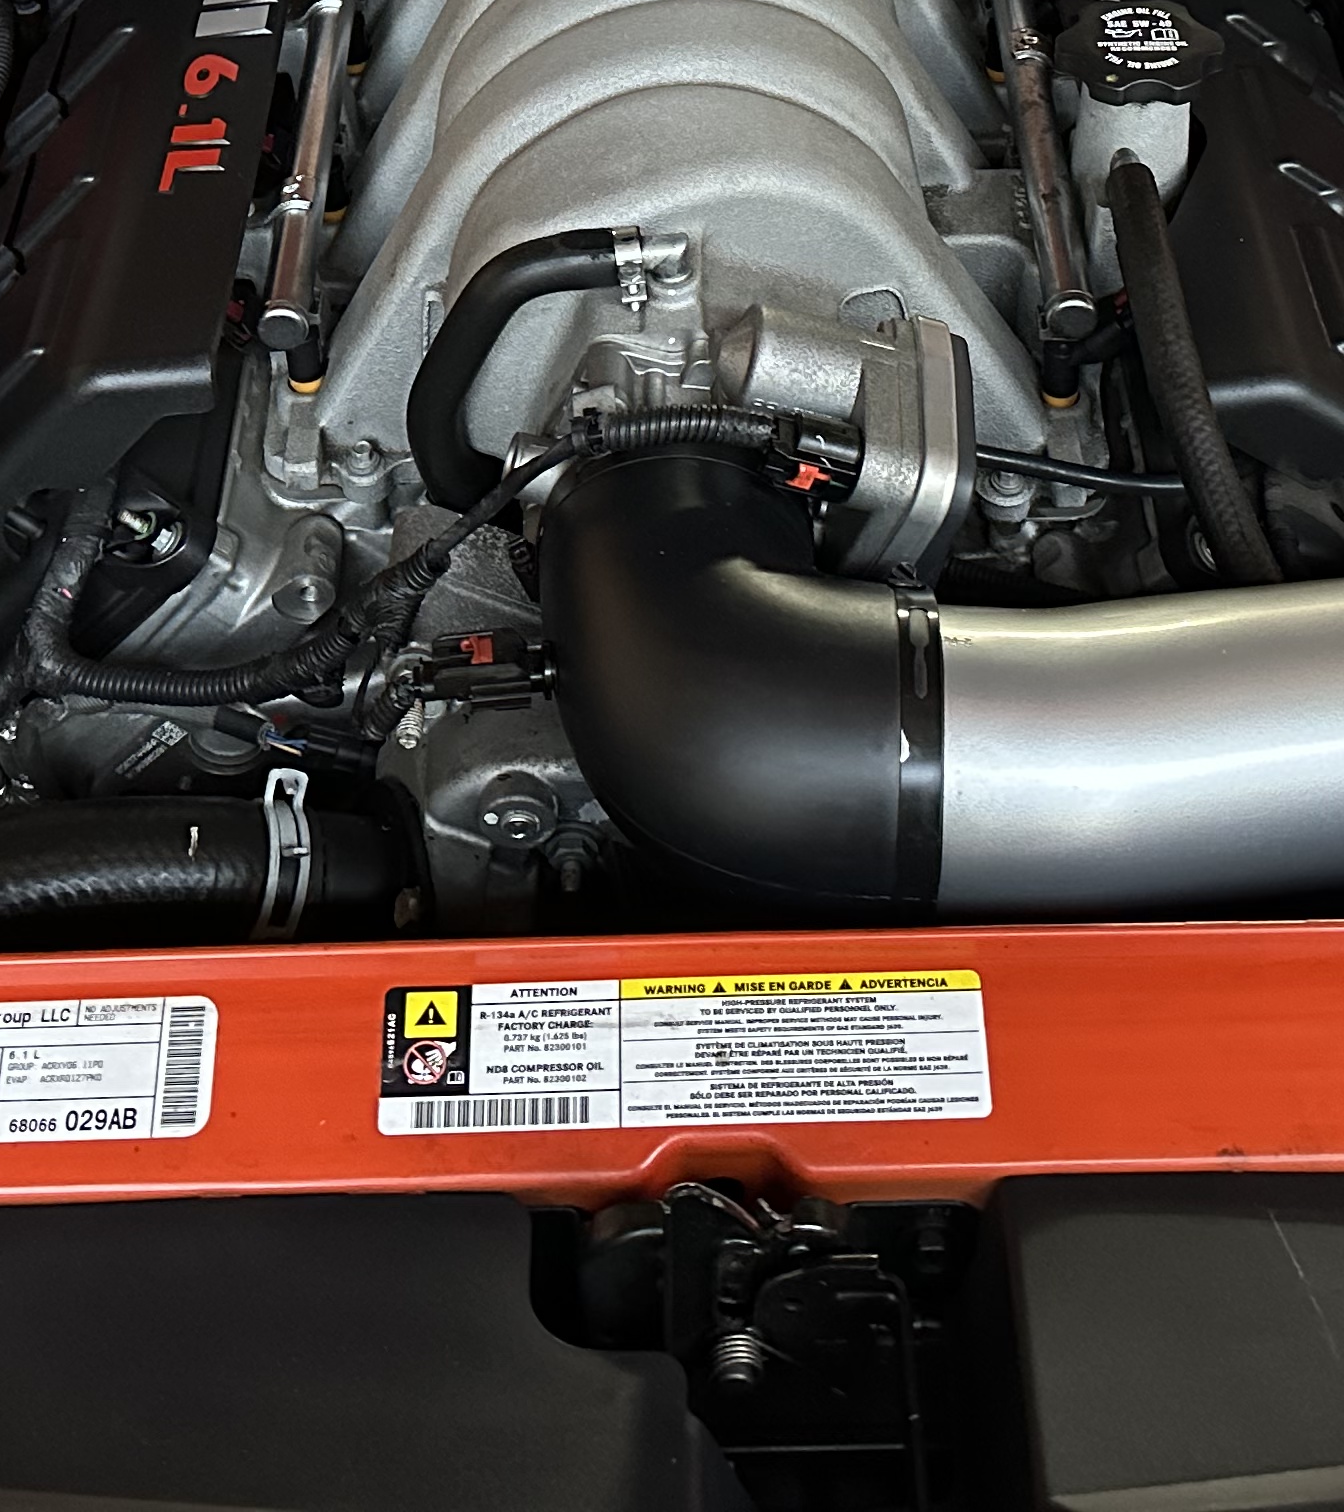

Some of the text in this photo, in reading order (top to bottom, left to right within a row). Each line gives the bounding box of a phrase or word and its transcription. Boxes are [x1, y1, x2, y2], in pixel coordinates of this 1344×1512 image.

[1135, 7, 1150, 15] OIL
[1107, 20, 1127, 28] SAE
[158, 53, 240, 193] 6.1L
[644, 978, 948, 994] WARNING MISE EN GARDE ADVERTENCIA
[510, 987, 578, 998] ATTENTION
[40, 1008, 71, 1023] LLC
[480, 1007, 612, 1019] R-134a A/C REFRIGERANT
[497, 1021, 545, 1031] FACTORY
[504, 1045, 525, 1053] PART
[511, 1063, 583, 1072] COMPRESSOR
[586, 1062, 604, 1070] OIL
[503, 1076, 524, 1084] PART
[9, 1107, 138, 1133] 68066 029AB
